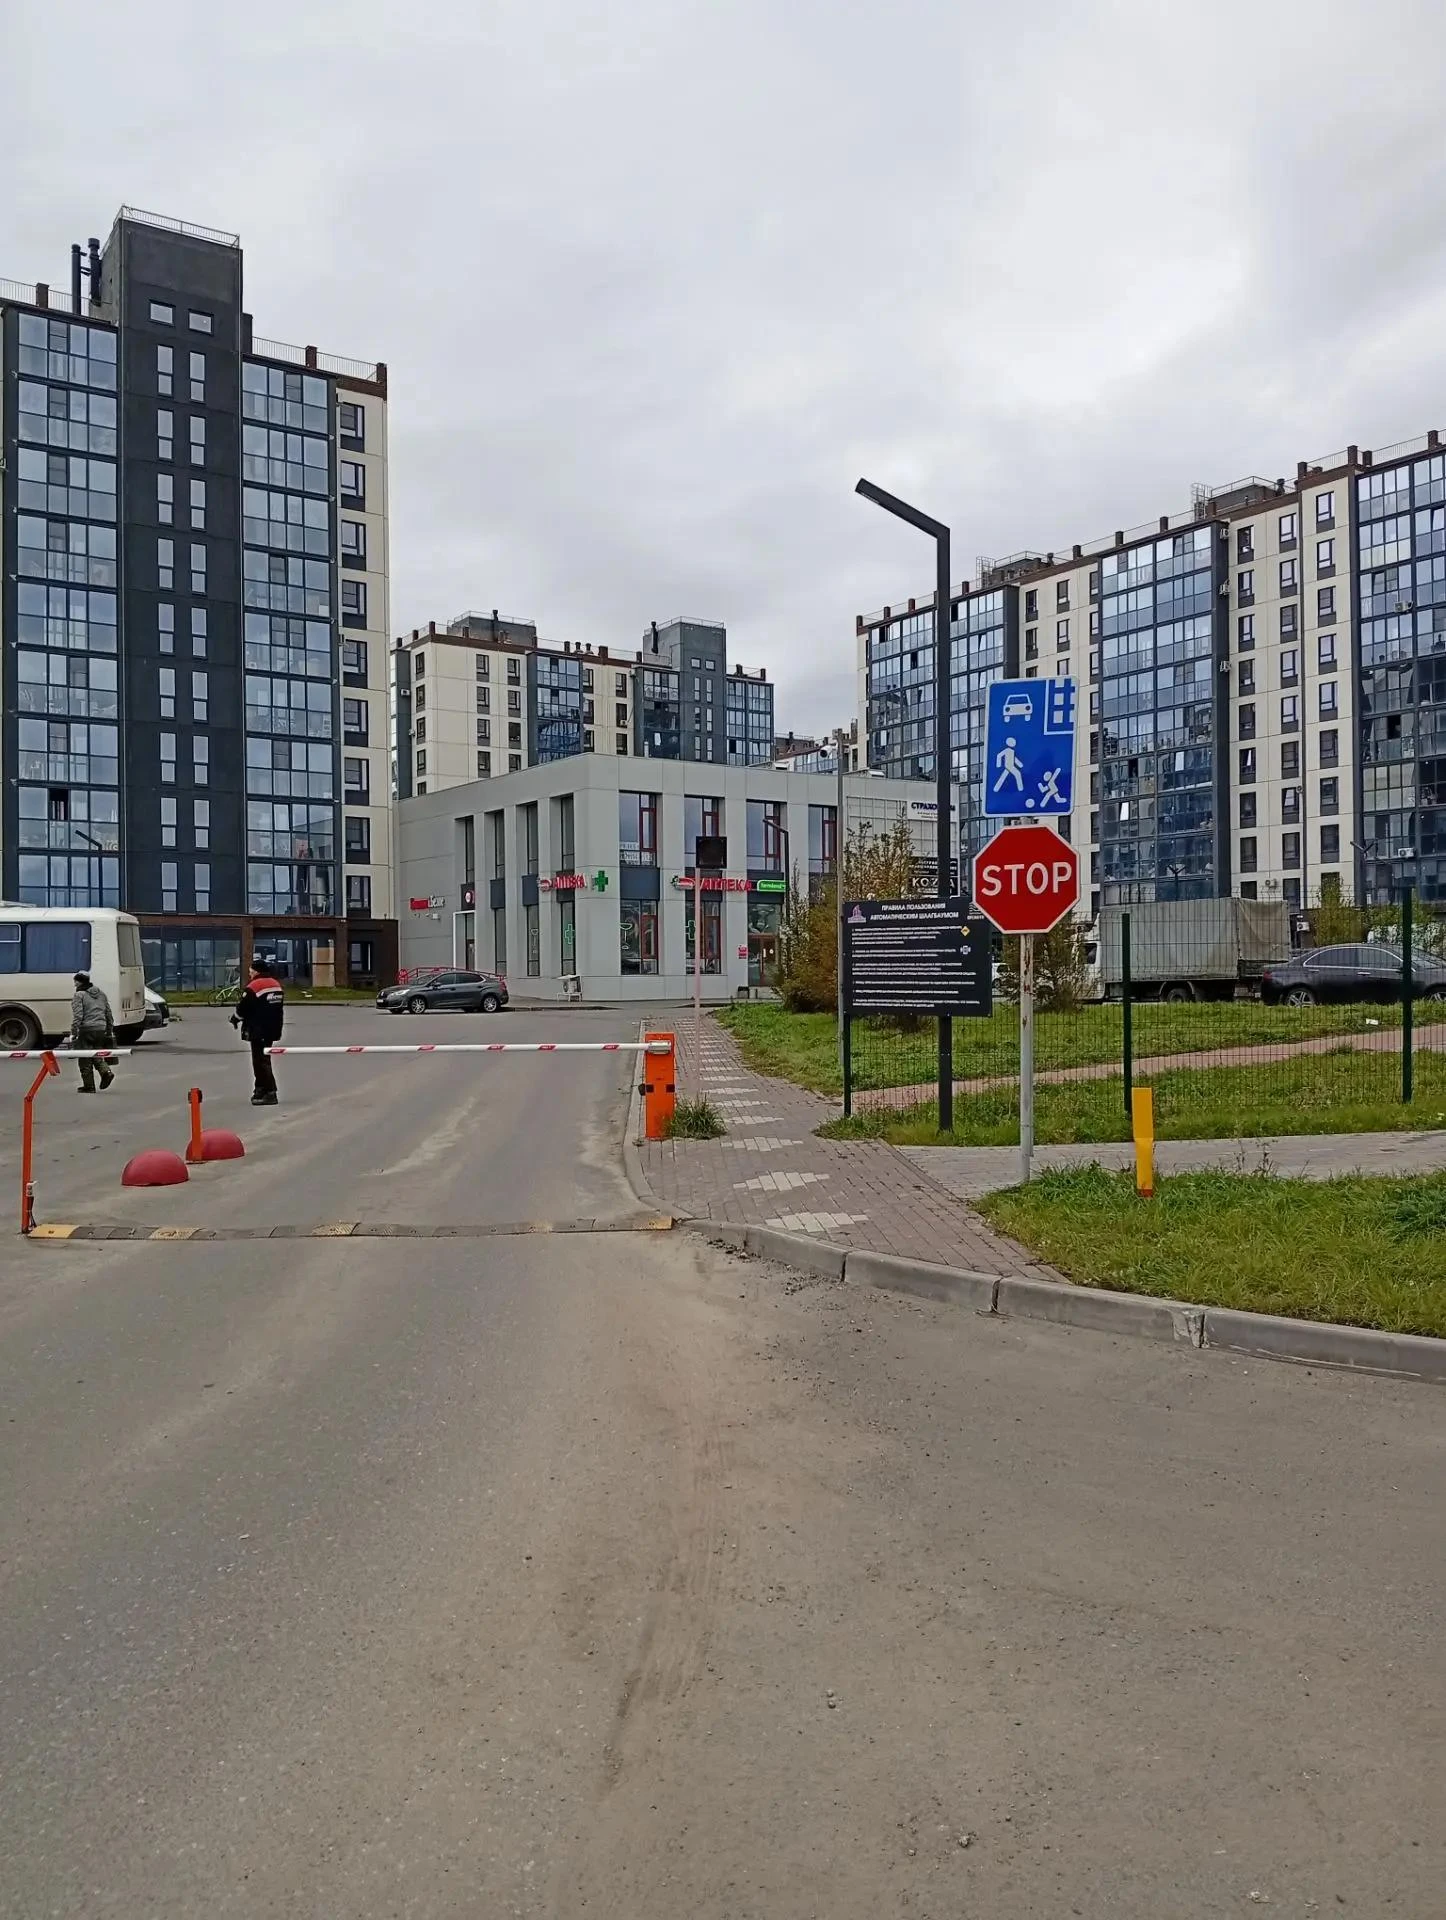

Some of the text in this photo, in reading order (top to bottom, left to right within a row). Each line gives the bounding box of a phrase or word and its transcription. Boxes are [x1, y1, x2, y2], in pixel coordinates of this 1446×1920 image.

[911, 801, 956, 812] СТРАХО
[700, 877, 752, 892] АПТЕКА
[981, 861, 1072, 897] STOP
[870, 913, 918, 921] АВТОМАТИЧЕСКИМ
[919, 912, 959, 920] ШЛАГБАУМОМ
